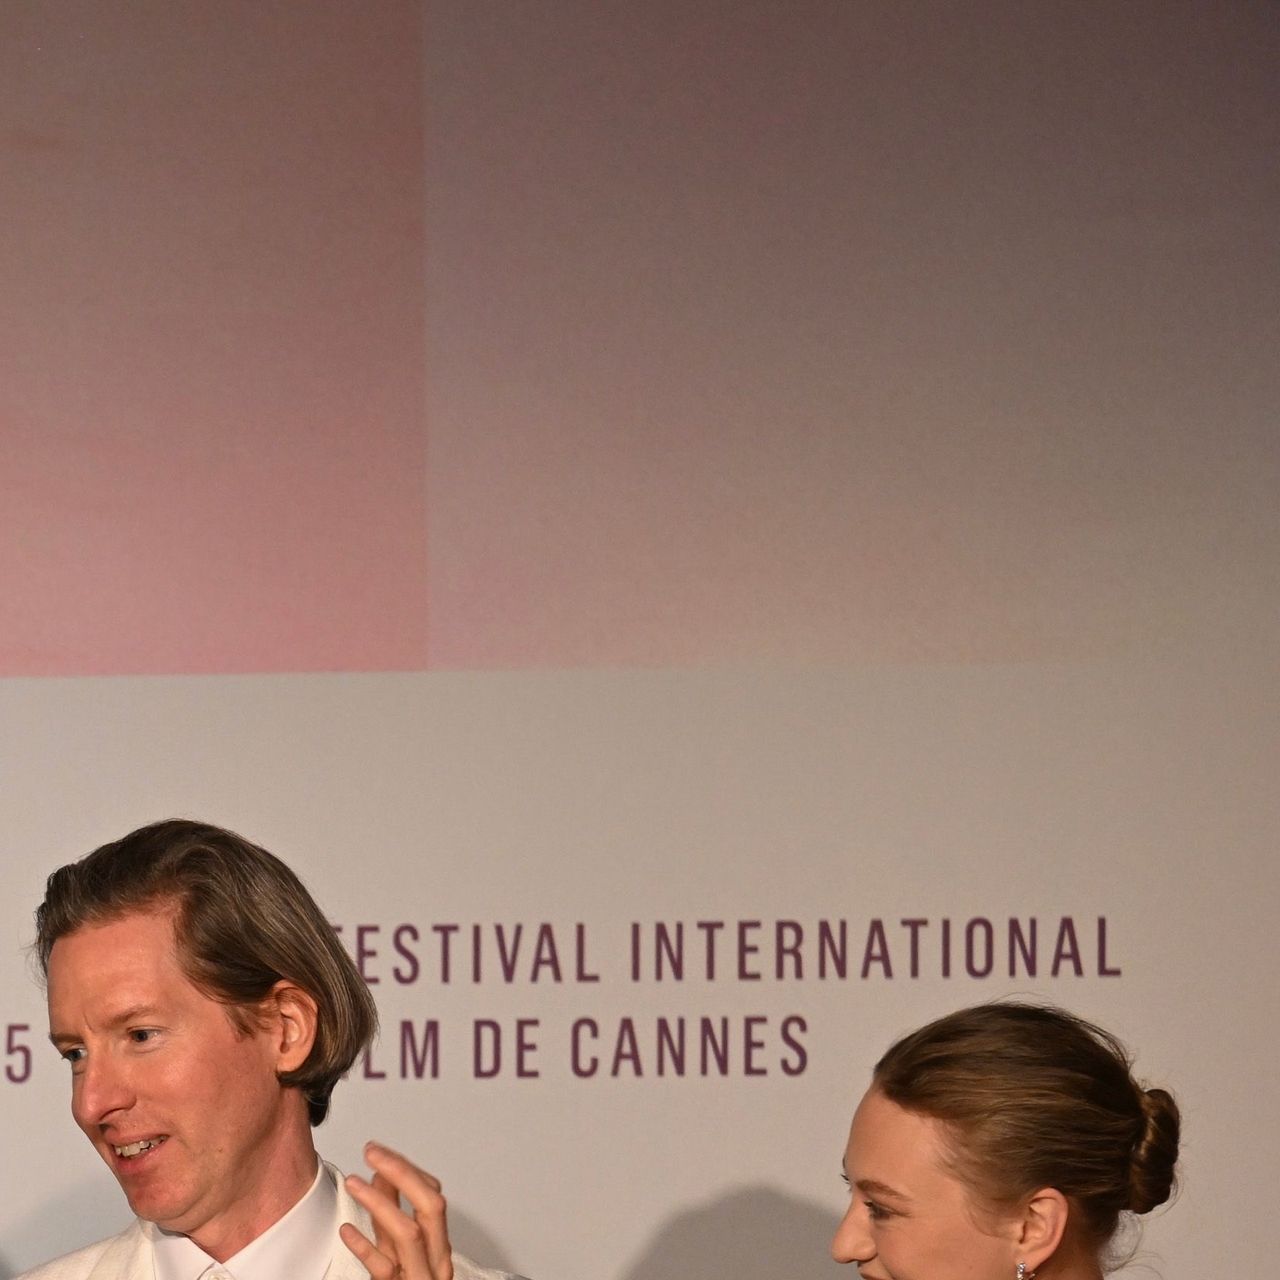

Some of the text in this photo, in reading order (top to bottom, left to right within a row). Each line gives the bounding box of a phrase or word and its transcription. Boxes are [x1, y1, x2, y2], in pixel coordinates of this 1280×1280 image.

[331, 916, 1123, 986] ESTIVAL INTERNATIONAL
[473, 1017, 541, 1080] DE
[571, 1014, 809, 1079] CANNES
